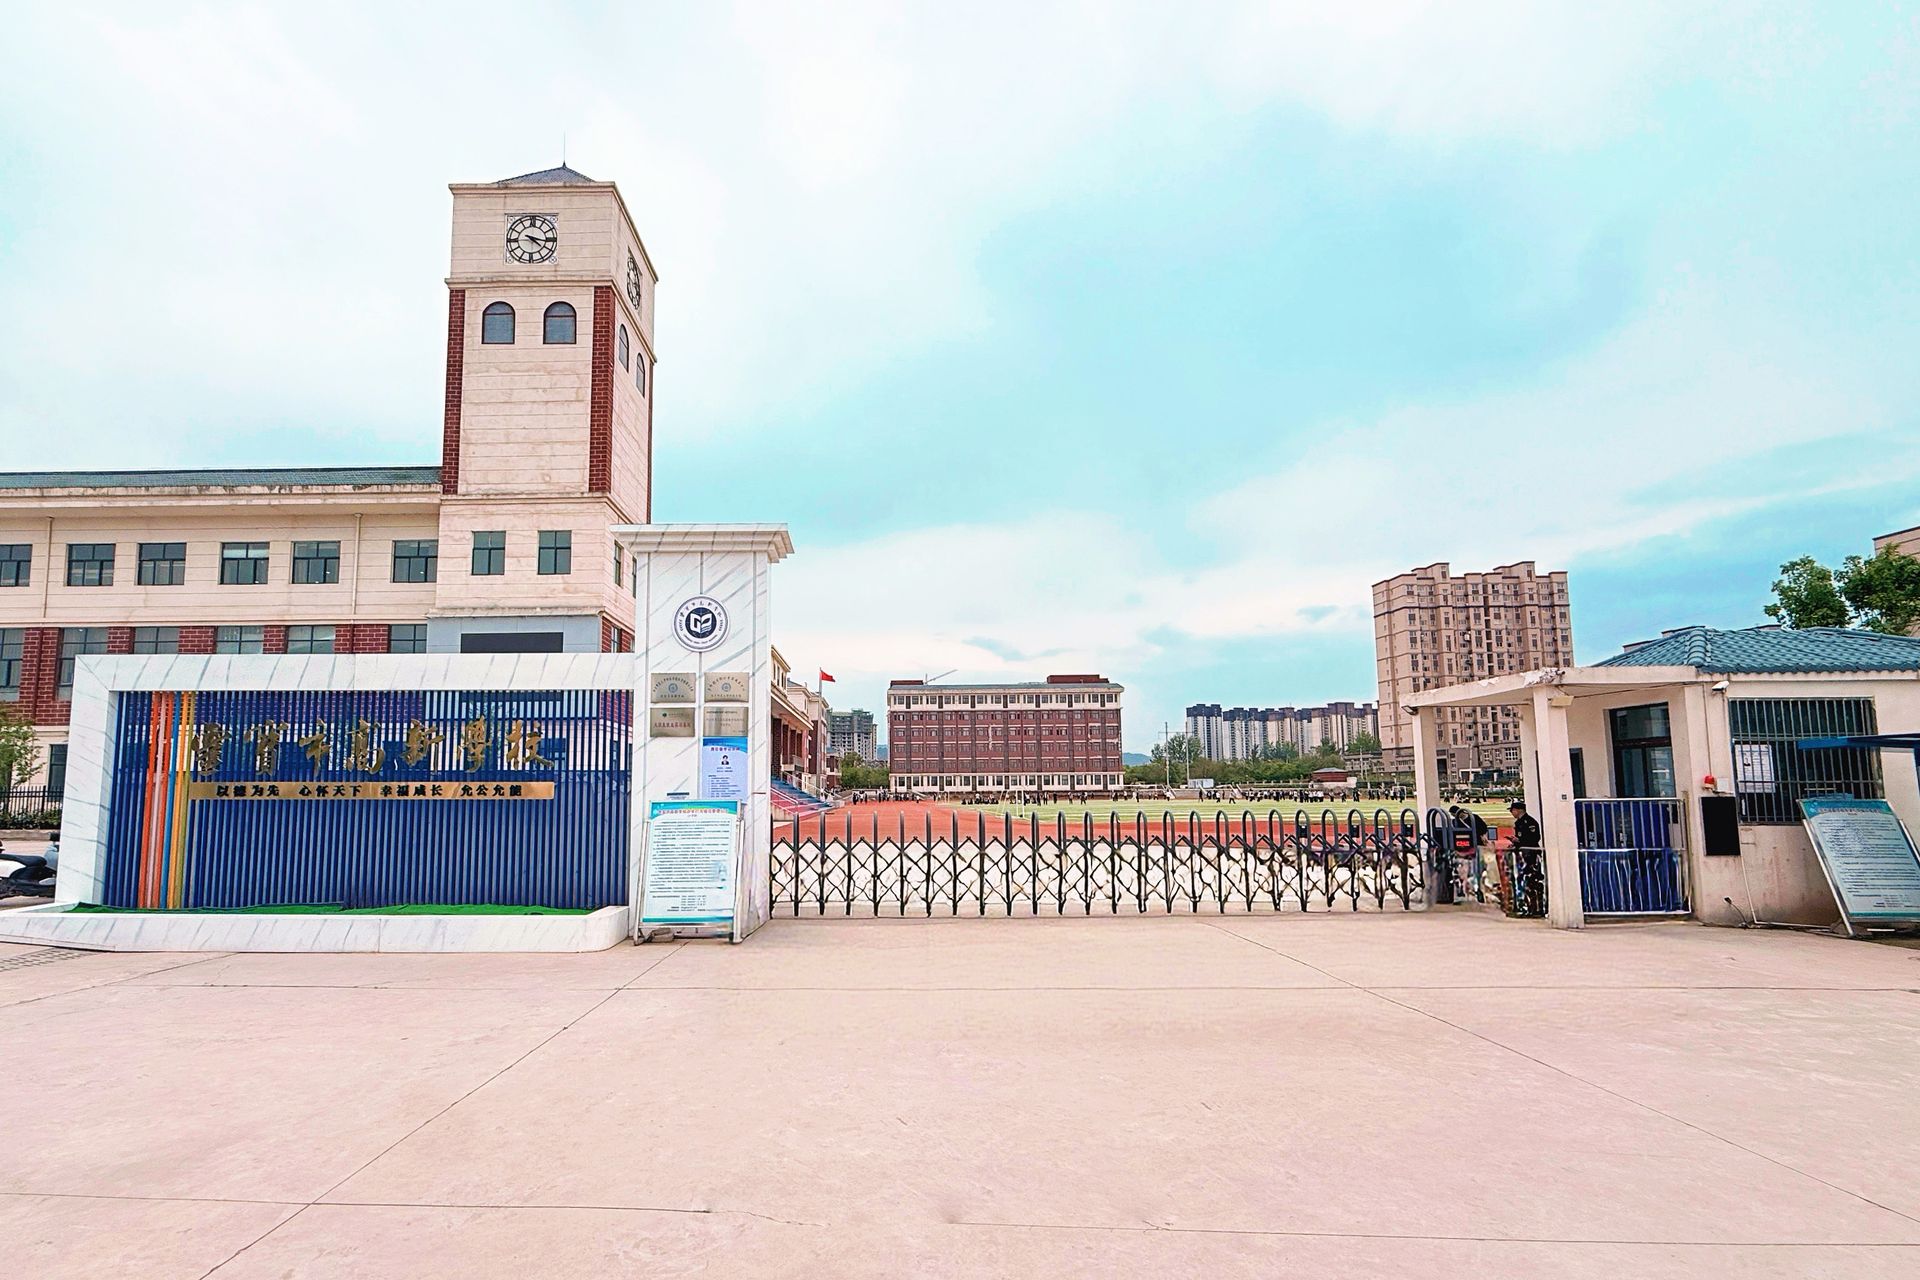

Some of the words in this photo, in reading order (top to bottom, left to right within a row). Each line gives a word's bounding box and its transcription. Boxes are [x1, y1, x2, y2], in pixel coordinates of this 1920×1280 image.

[216, 785, 280, 797] 以德为先
[298, 785, 362, 797] 心怀天下
[381, 785, 444, 797] 幸福成长
[460, 785, 523, 797] 允公允能
